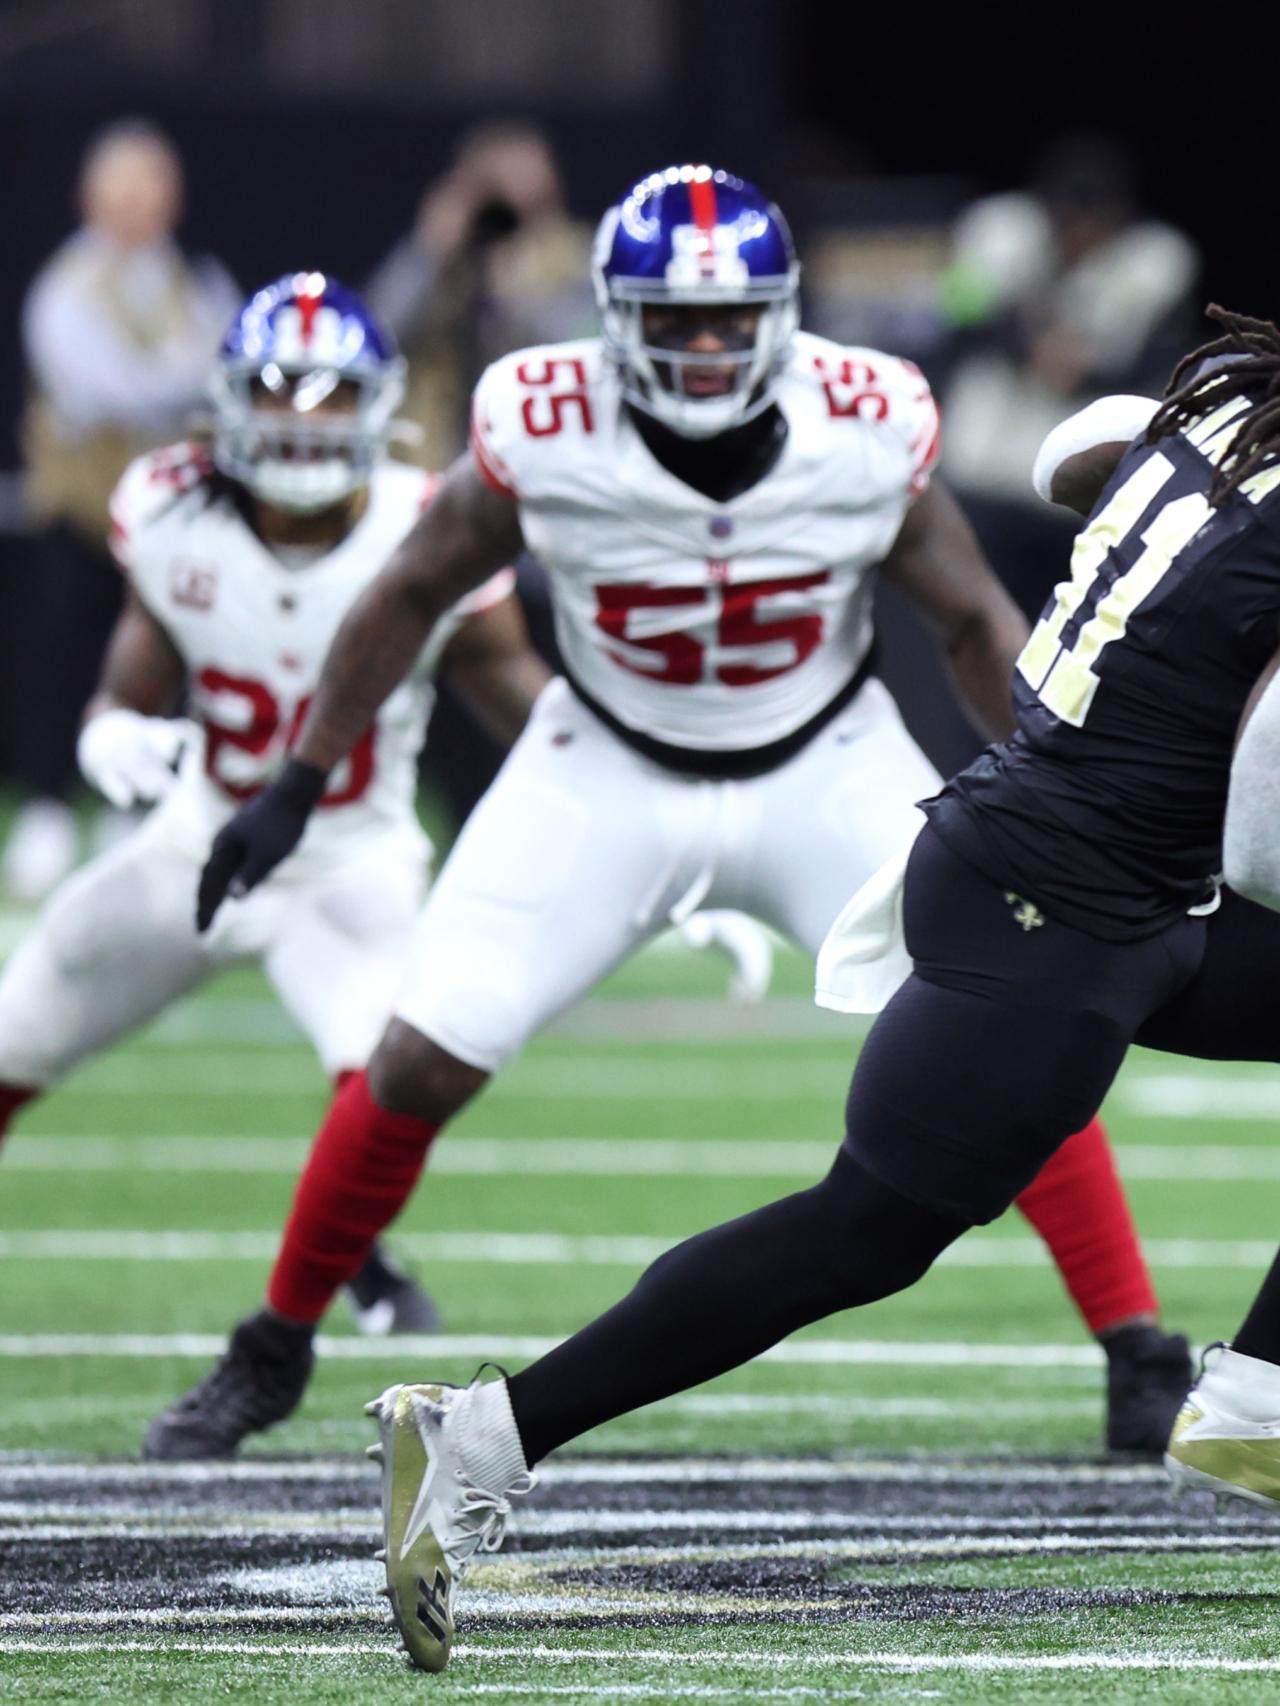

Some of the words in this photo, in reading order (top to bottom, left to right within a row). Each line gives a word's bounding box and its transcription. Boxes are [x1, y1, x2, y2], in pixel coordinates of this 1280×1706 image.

[517, 358, 594, 436] 55
[813, 357, 889, 421] 55
[594, 571, 829, 688] 55
